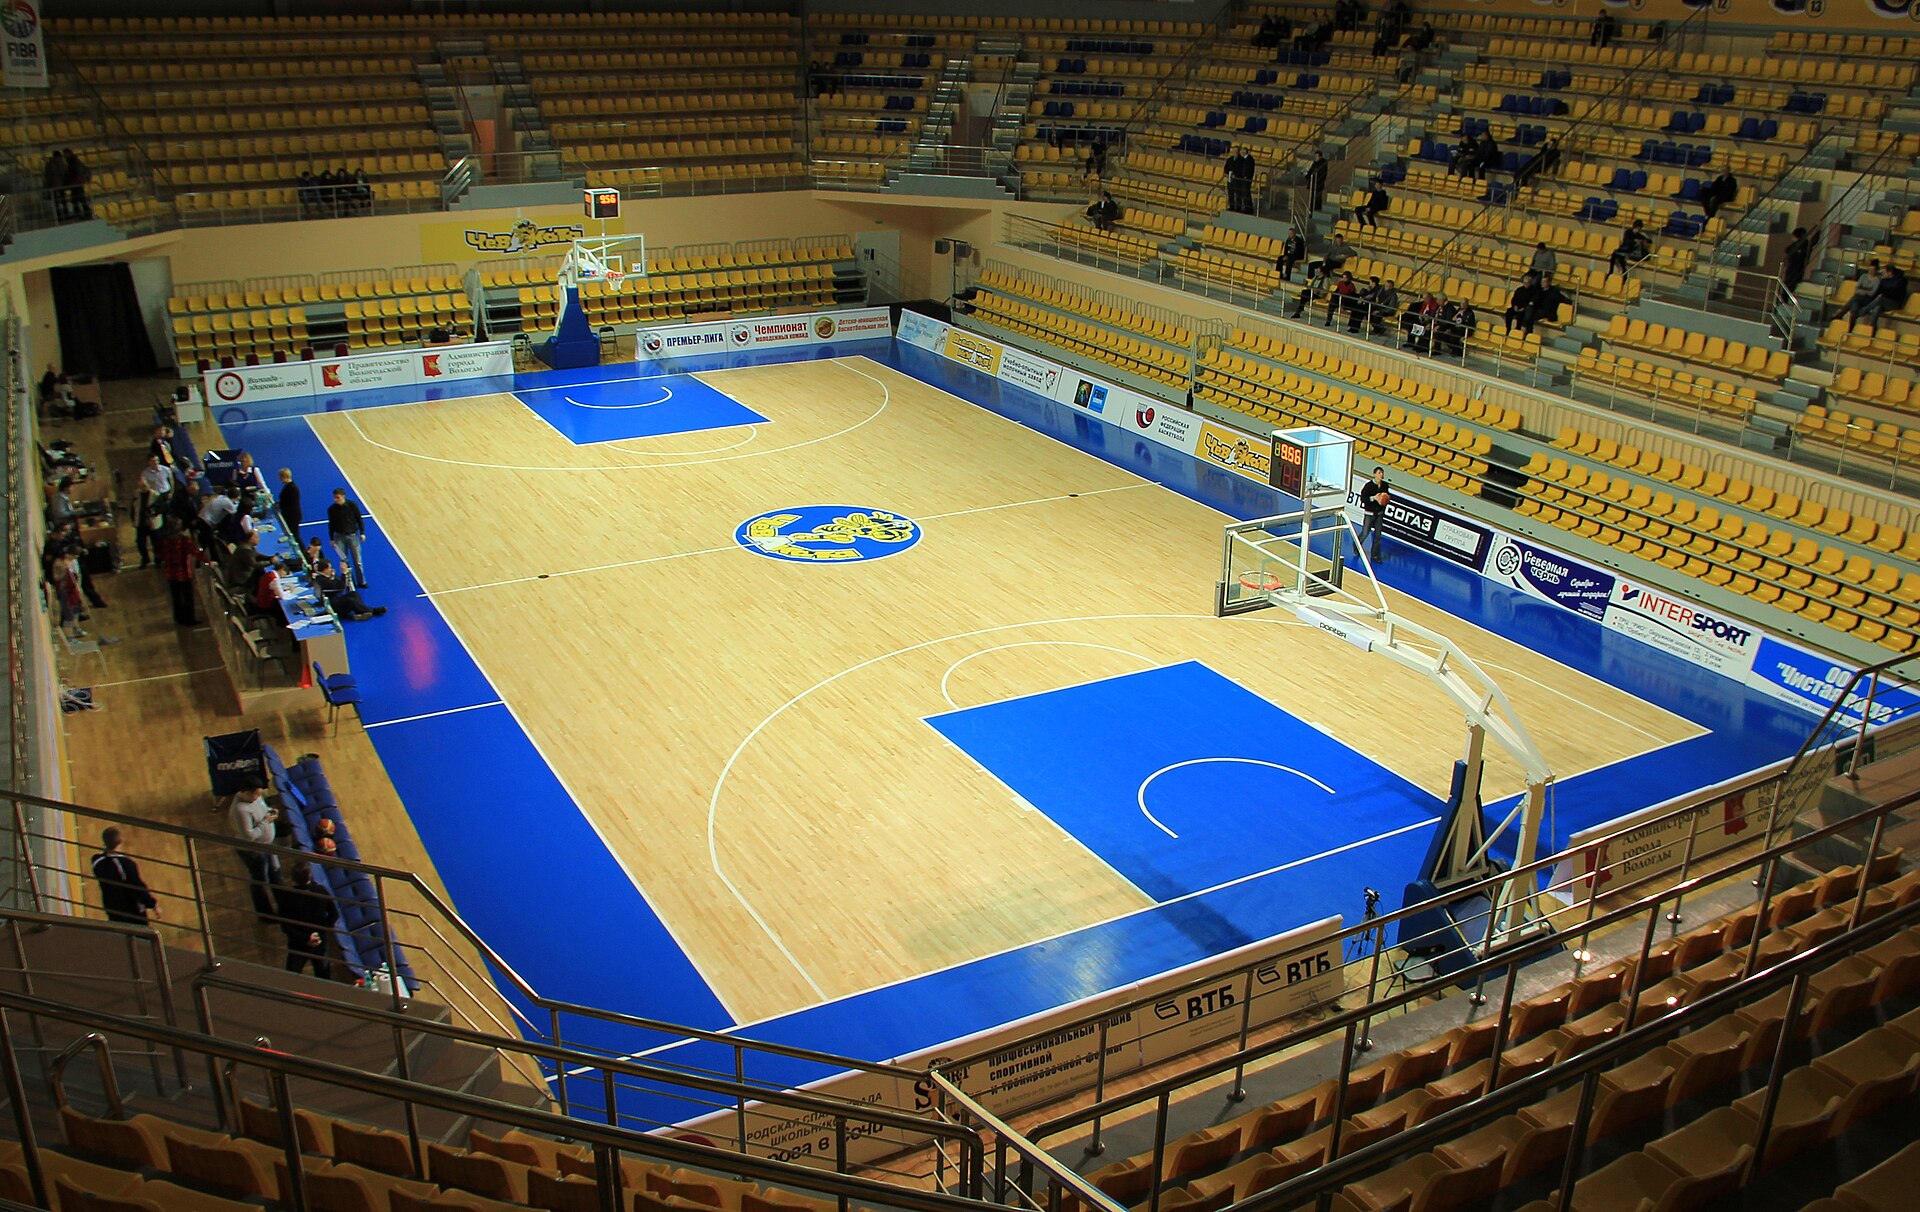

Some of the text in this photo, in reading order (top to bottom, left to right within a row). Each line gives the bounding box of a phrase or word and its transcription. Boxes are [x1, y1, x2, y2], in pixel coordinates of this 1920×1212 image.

[6, 41, 38, 58] FIBA
[754, 322, 807, 335] Чемпионат
[666, 332, 724, 347] ПРЕМЬЕР-ЛИГА
[447, 350, 509, 362] Администрация
[348, 357, 410, 371] Правительство
[447, 360, 475, 370] города
[449, 366, 484, 375] Вологды
[349, 366, 403, 378] Вологодской
[1385, 504, 1433, 532] СОГАЗ
[1444, 534, 1467, 547] ГРУППА
[1638, 592, 1751, 647] INTERSPORT
[1286, 950, 1332, 985] ВТБ
[1186, 984, 1236, 1020] ВТБ
